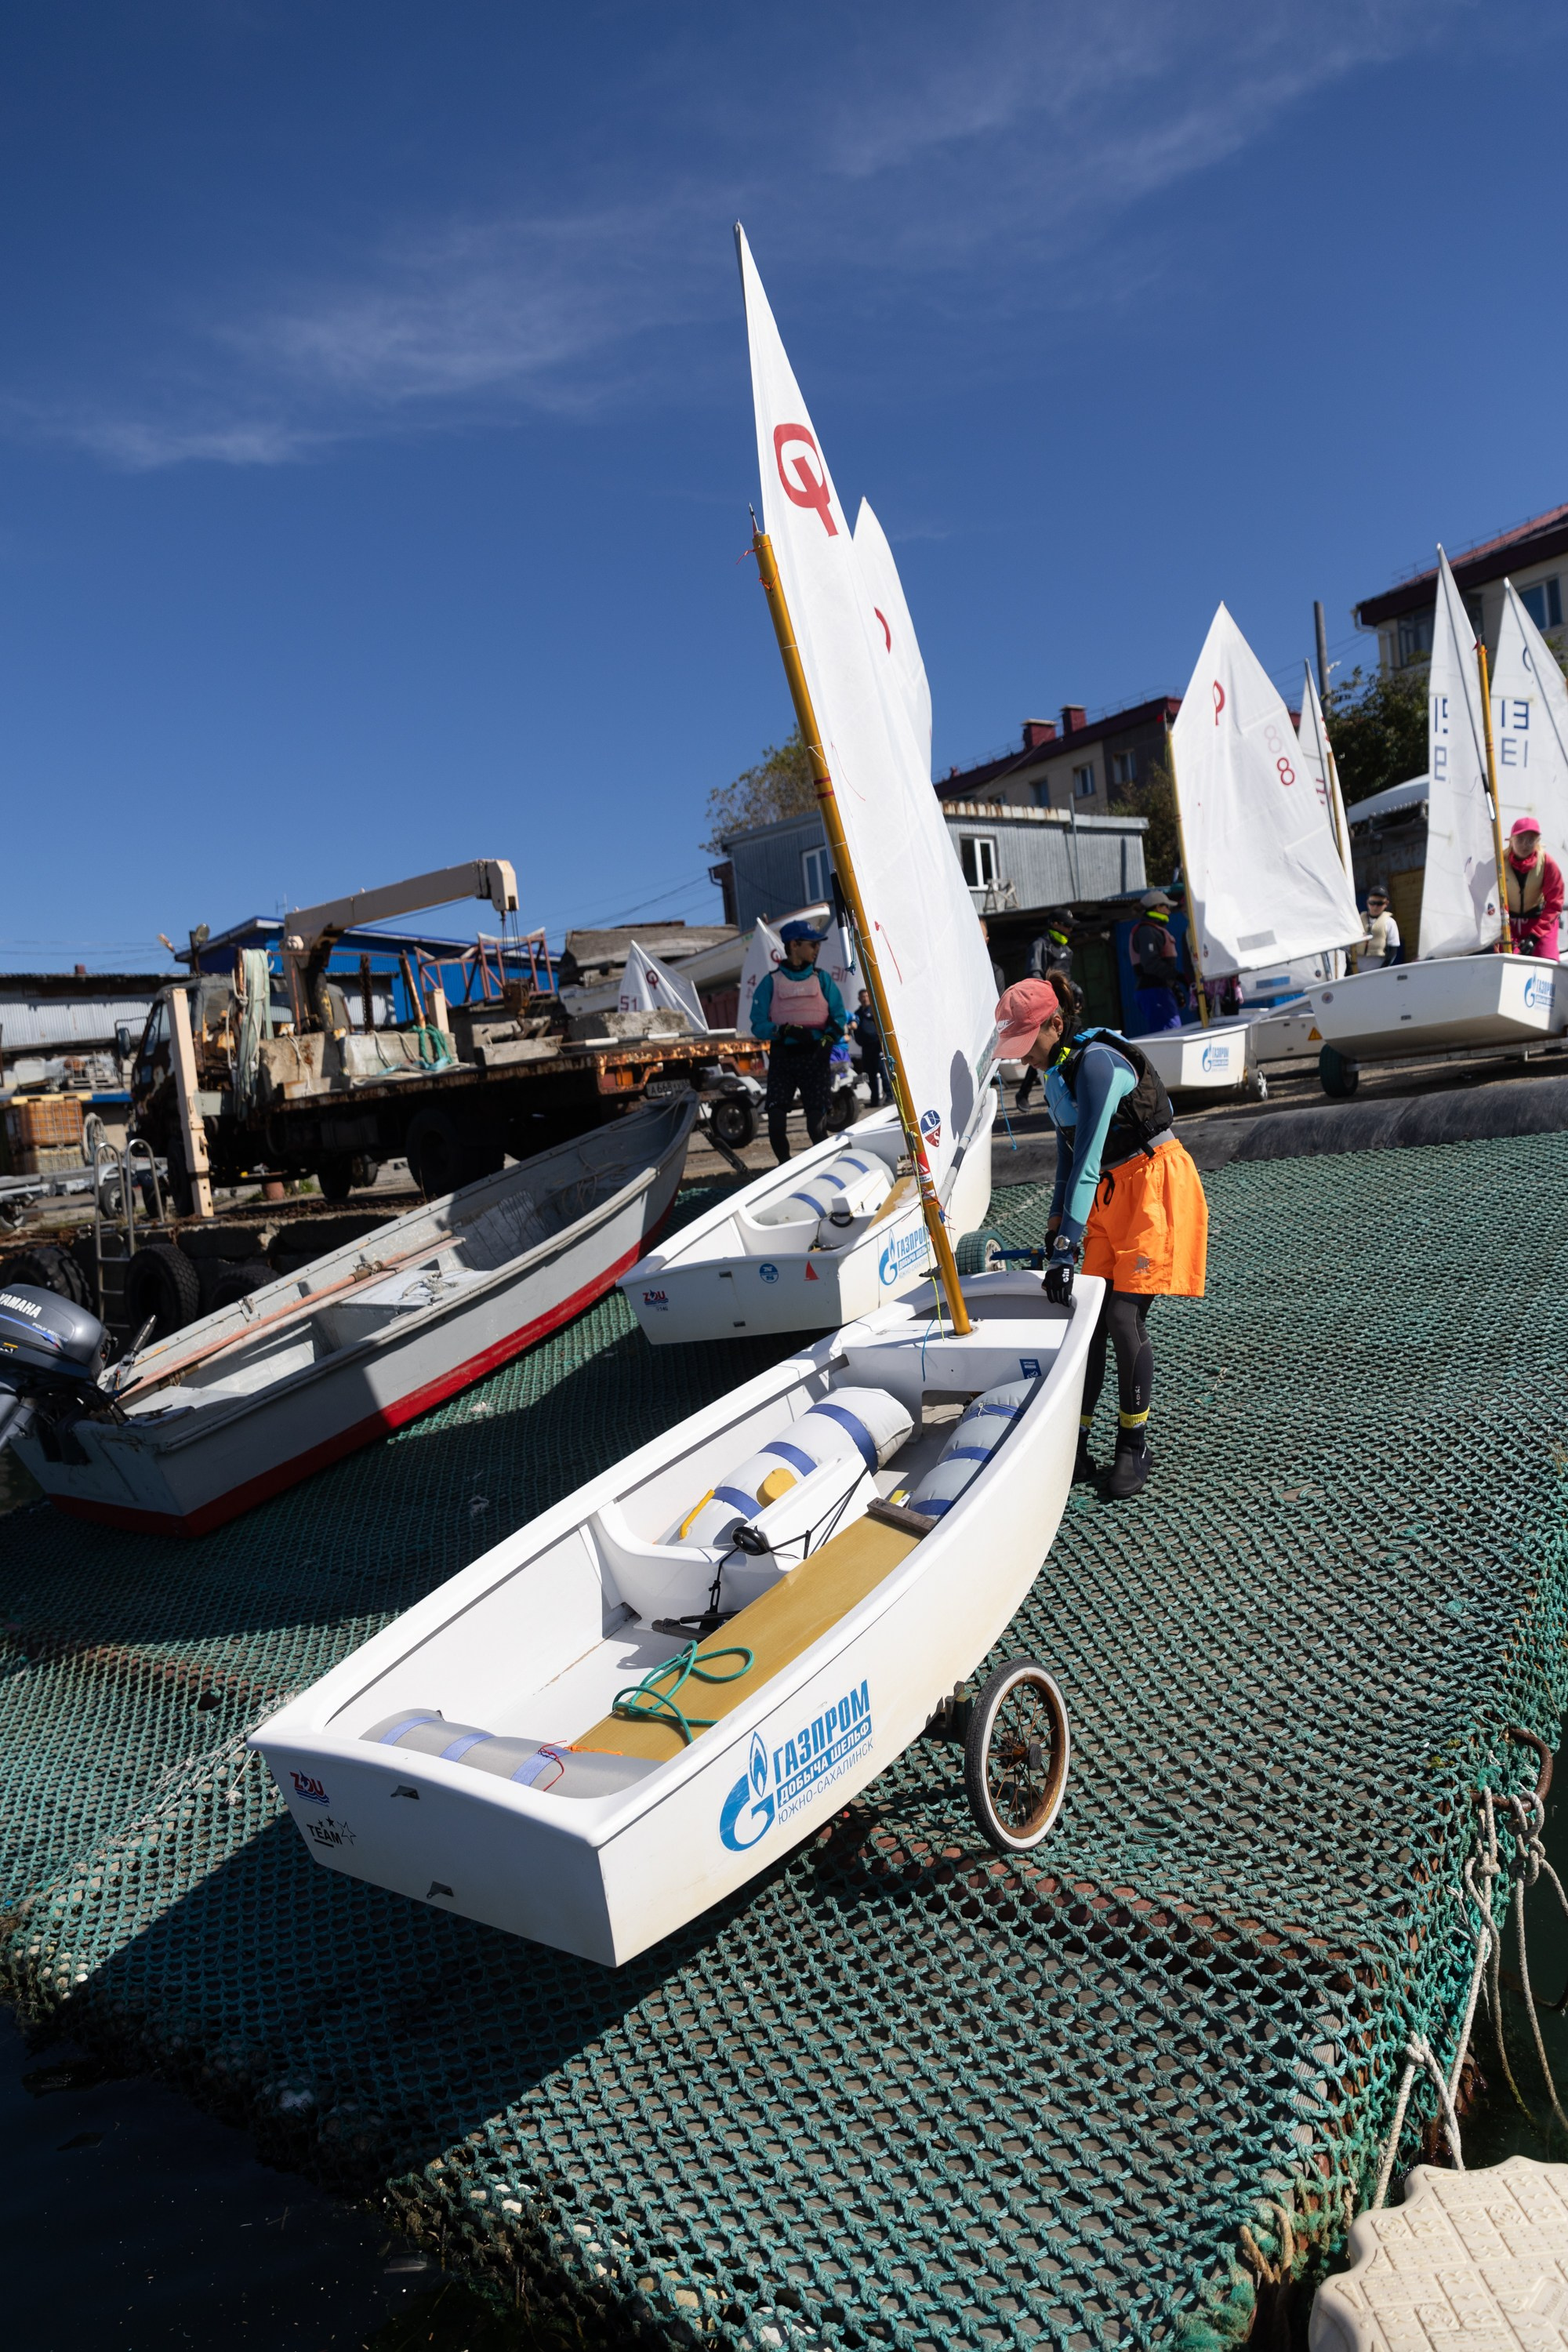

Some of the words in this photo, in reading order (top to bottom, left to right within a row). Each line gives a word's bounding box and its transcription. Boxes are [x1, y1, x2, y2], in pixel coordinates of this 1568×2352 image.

[1277, 757, 1295, 786] 8
[0, 1293, 42, 1318] YAMAHA
[772, 1679, 870, 1785] ГАЗПРОМ
[779, 1755, 829, 1806] ДОБЫЧА
[830, 1722, 869, 1762] ШЕЛЬФ
[779, 1737, 873, 1825] ЮЖНО-САХАЛИНСК
[307, 1824, 343, 1845] TEAM
